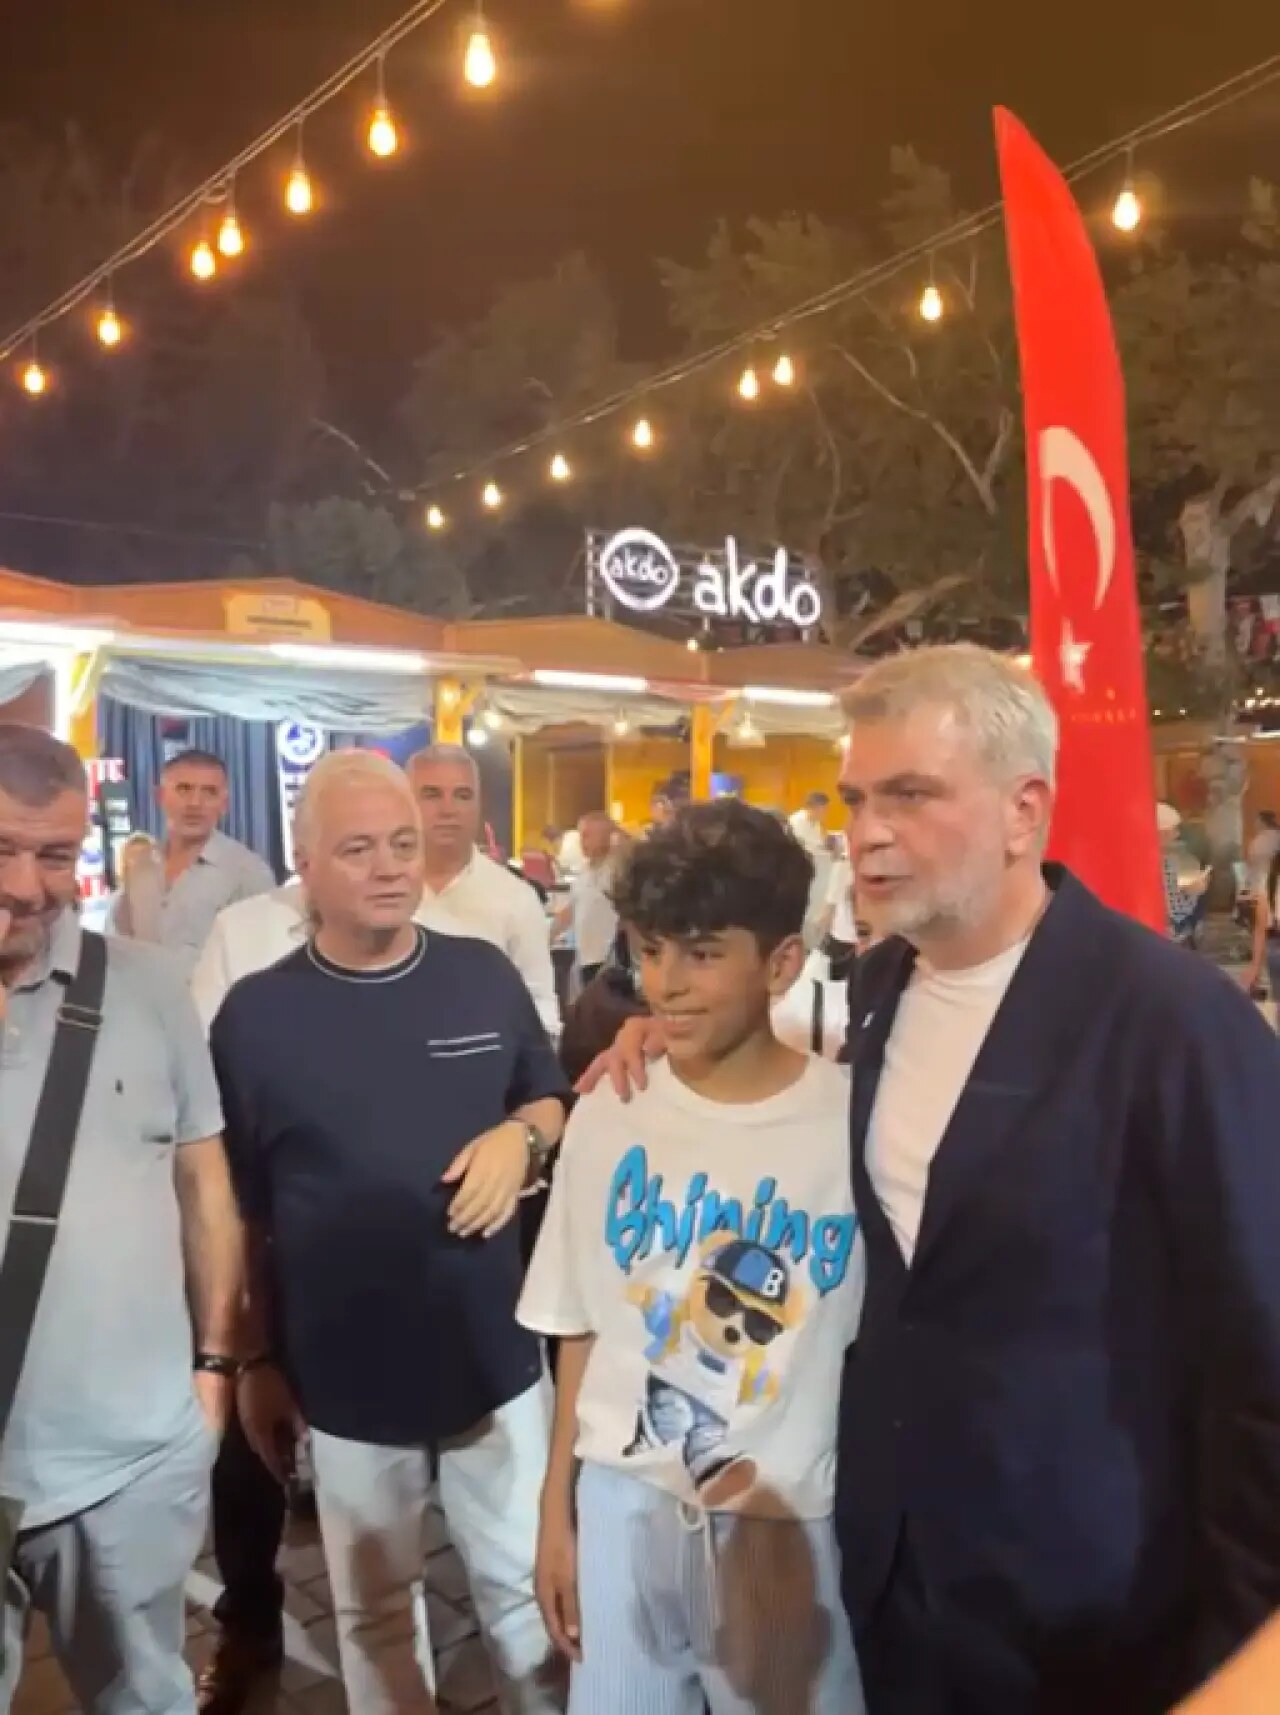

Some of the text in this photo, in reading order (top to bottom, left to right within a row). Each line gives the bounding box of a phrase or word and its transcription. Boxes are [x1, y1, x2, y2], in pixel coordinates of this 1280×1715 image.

[694, 534, 821, 625] akdo
[605, 1144, 855, 1297] Shining
[761, 1268, 784, 1296] B
